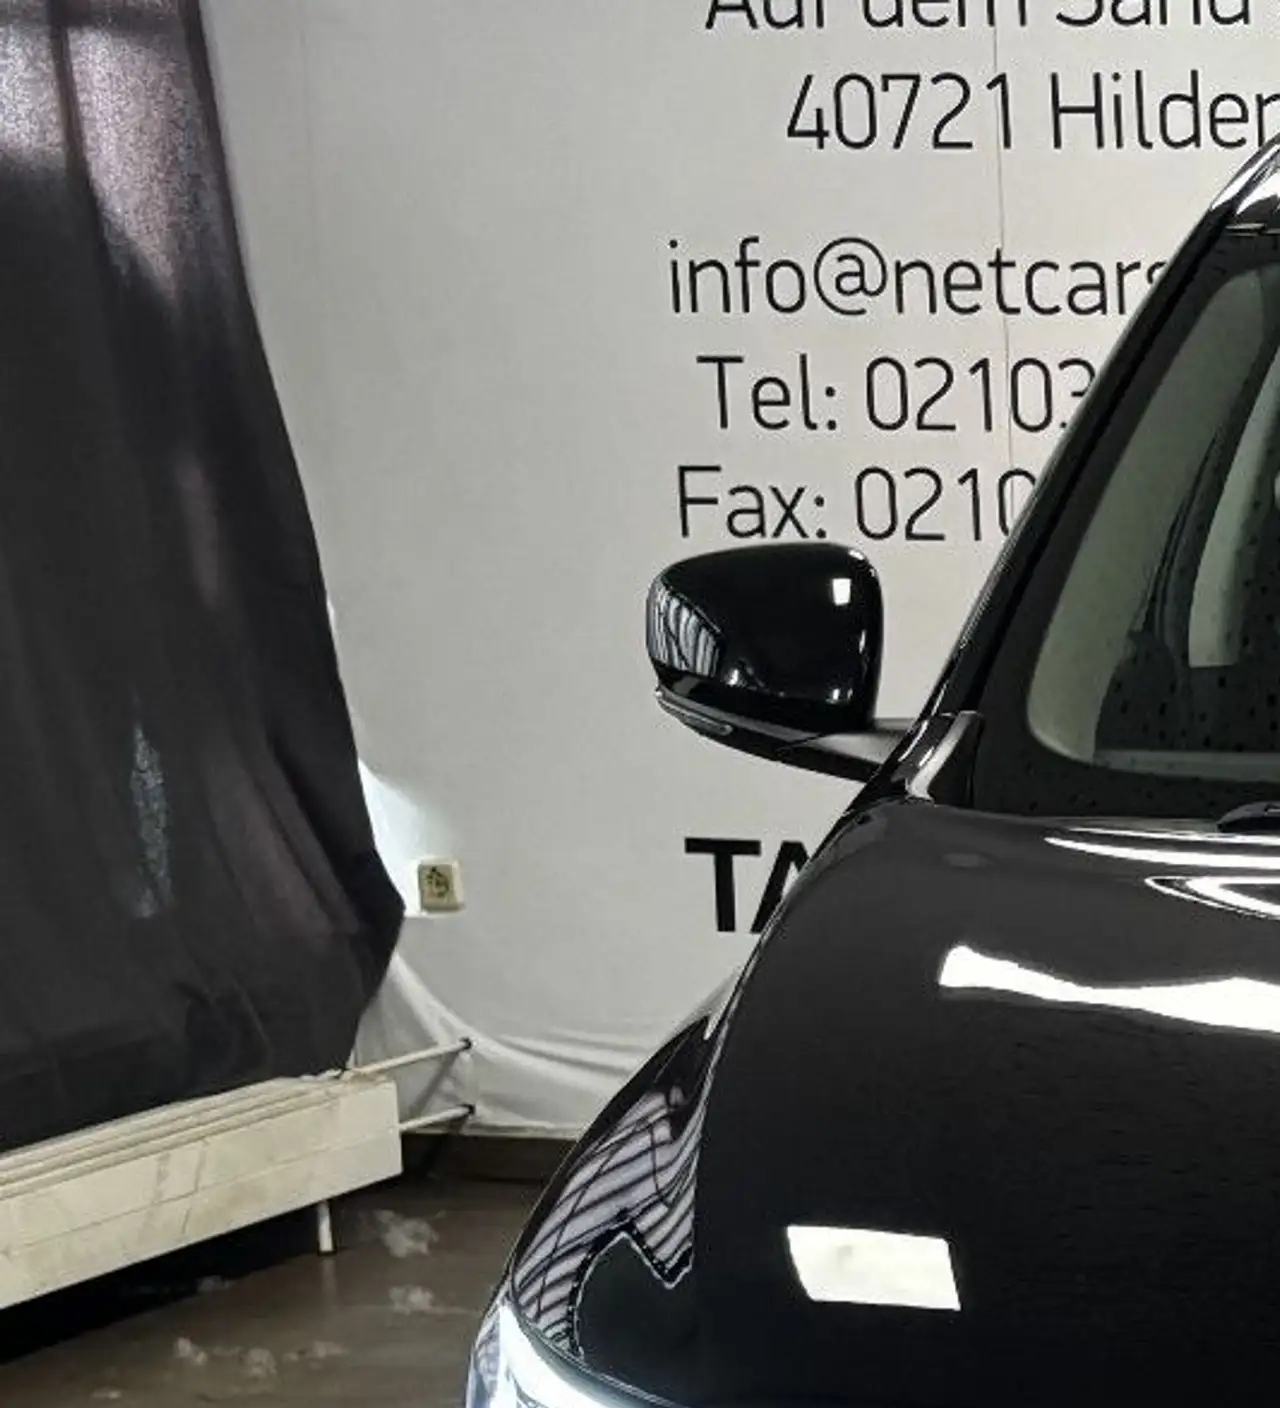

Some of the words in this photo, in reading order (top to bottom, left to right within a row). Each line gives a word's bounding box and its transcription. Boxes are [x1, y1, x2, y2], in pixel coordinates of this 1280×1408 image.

[787, 72, 1013, 149] 40721
[697, 354, 838, 431] Tel:
[677, 465, 828, 539] Fax:
